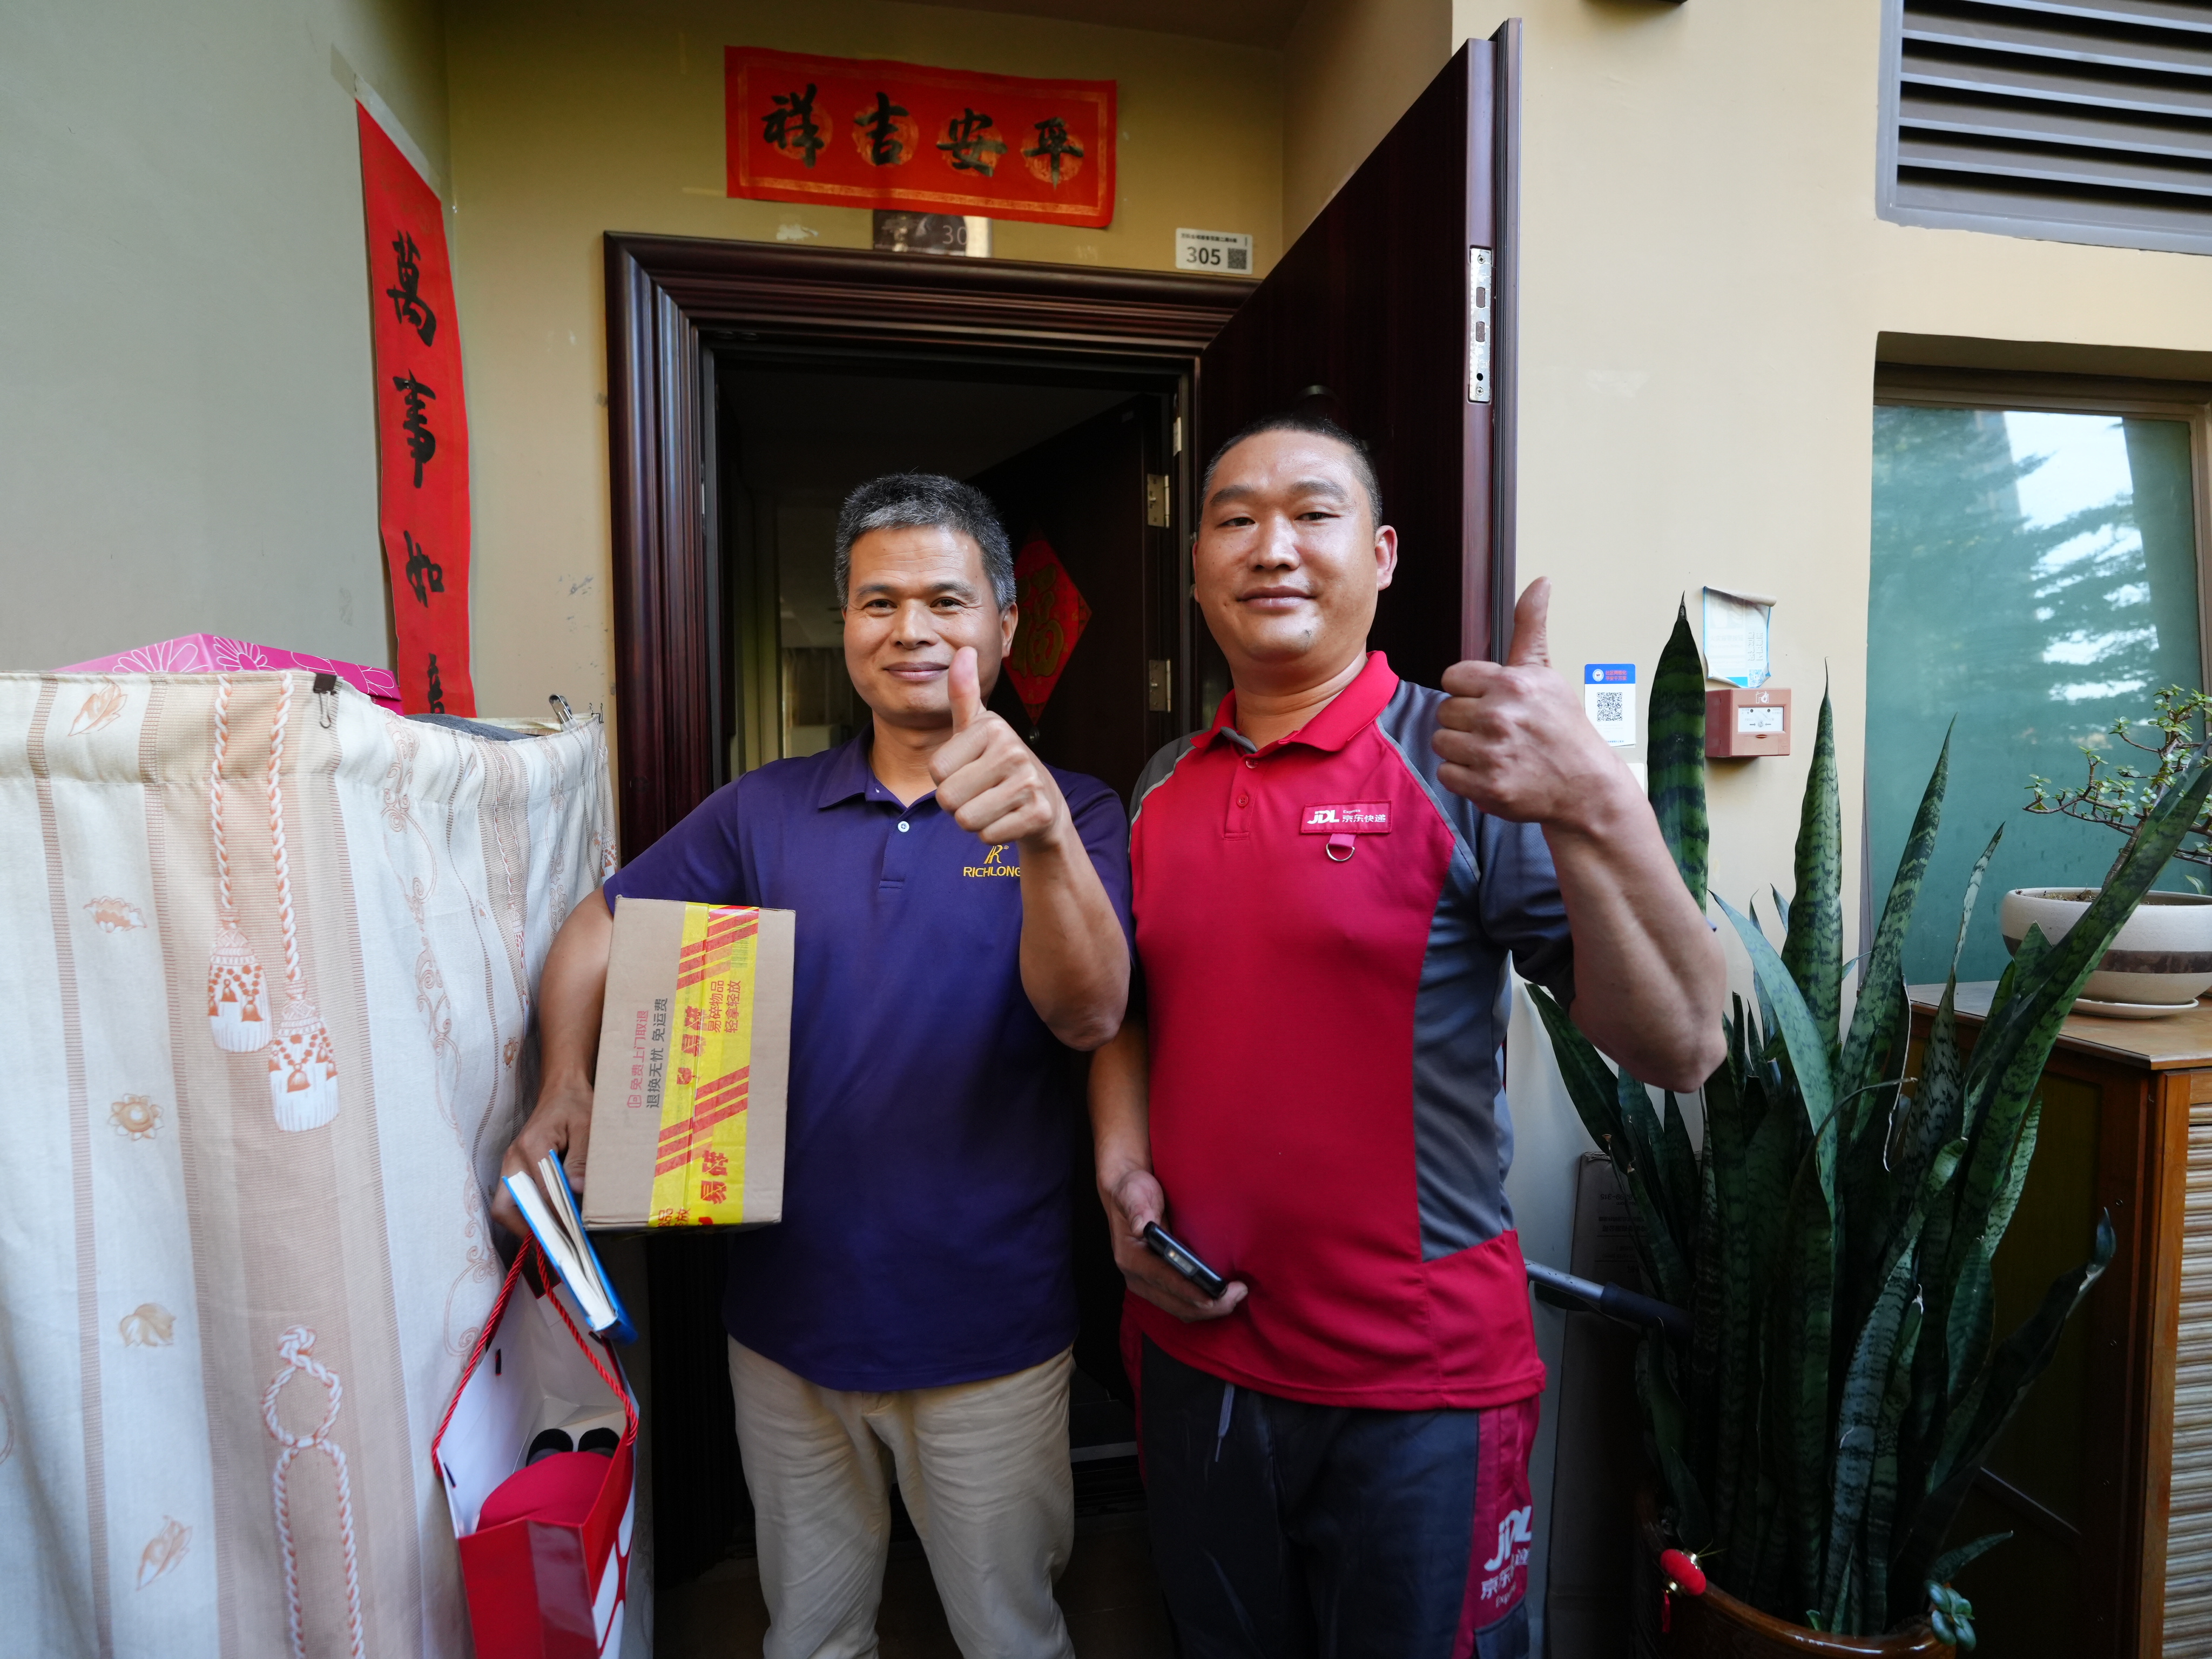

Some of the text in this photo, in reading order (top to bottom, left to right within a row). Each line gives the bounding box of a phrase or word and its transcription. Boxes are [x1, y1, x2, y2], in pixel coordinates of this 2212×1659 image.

[1186, 246, 1220, 265] 305
[1307, 810, 1339, 824] JDL
[1342, 814, 1386, 822] 京东快递
[707, 980, 724, 1033] 易碎物品
[724, 980, 741, 1033] 轻拿轻放
[630, 1010, 649, 1091] 免费上门取退
[646, 998, 668, 1108] 退换无忧 免运费
[700, 1150, 729, 1204] 易碎
[675, 1208, 691, 1226] 放
